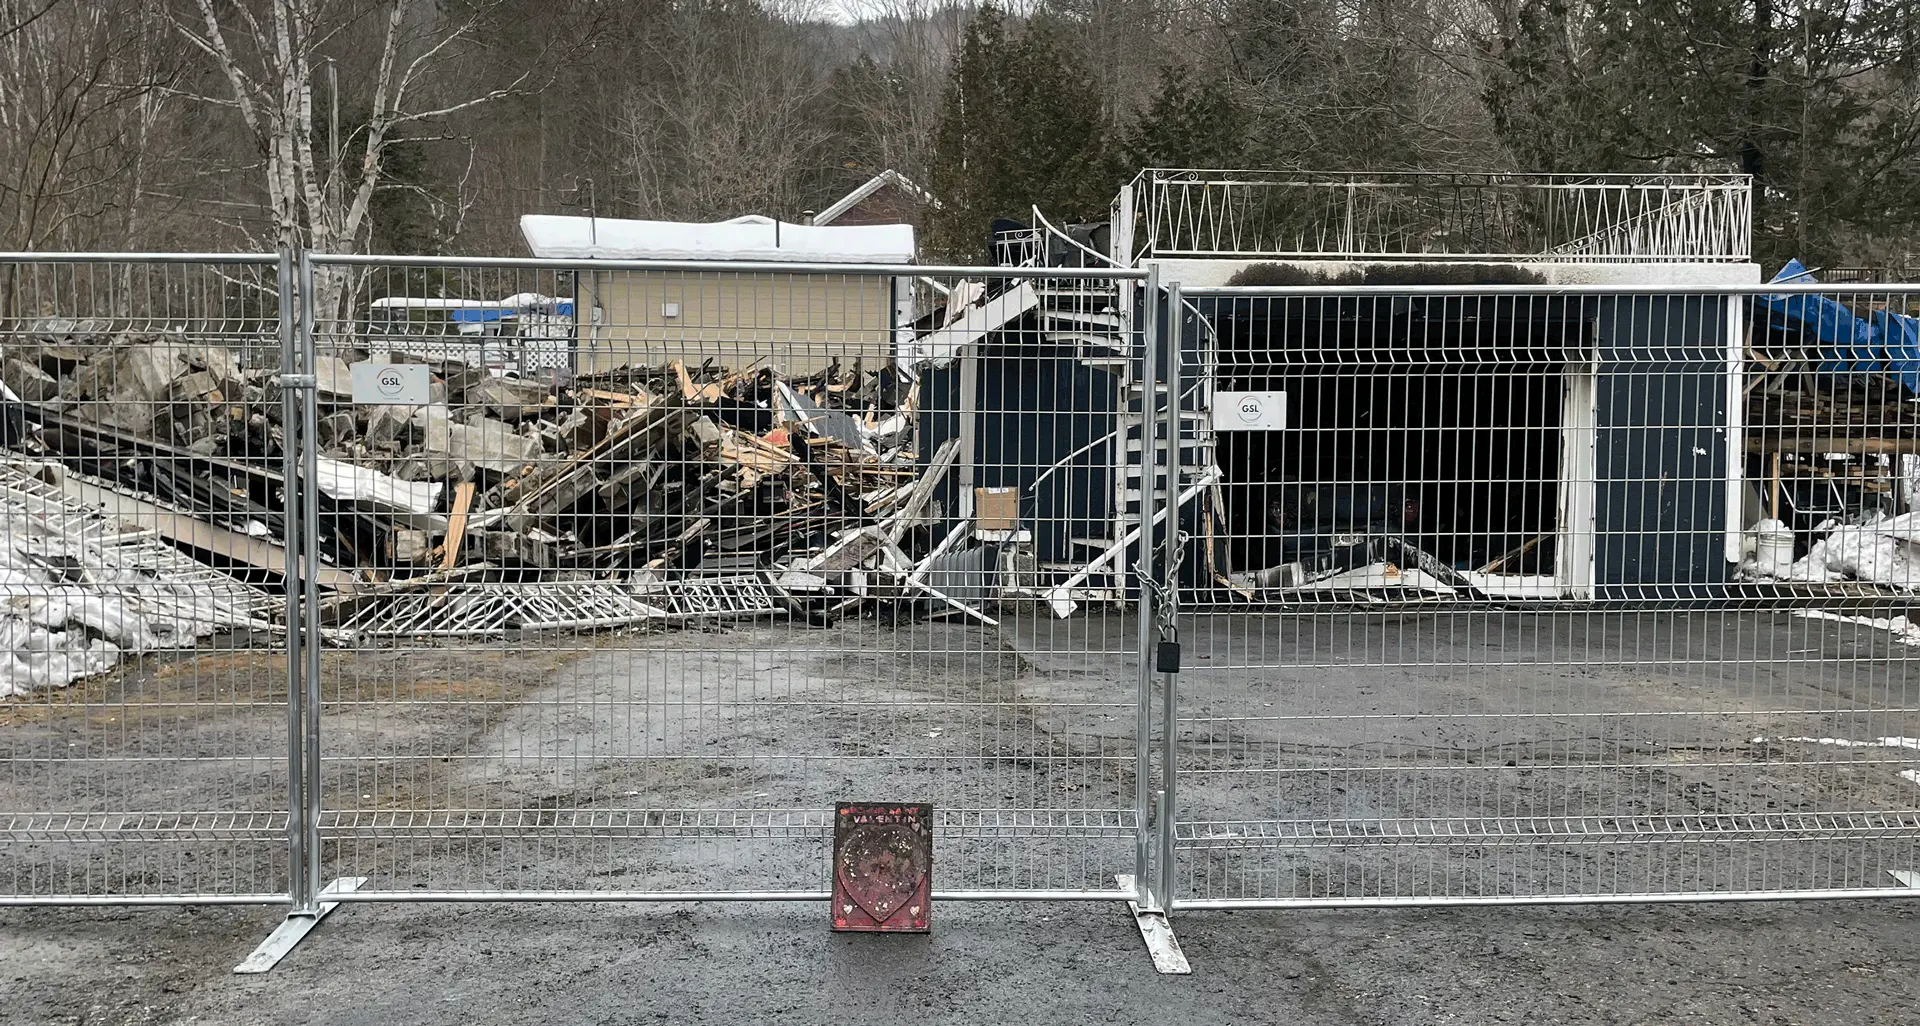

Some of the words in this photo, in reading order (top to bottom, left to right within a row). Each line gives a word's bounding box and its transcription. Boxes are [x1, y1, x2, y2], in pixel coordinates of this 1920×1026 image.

[381, 377, 401, 386] GSL
[1241, 404, 1259, 413] GSL
[853, 815, 916, 824] VALENTIN
